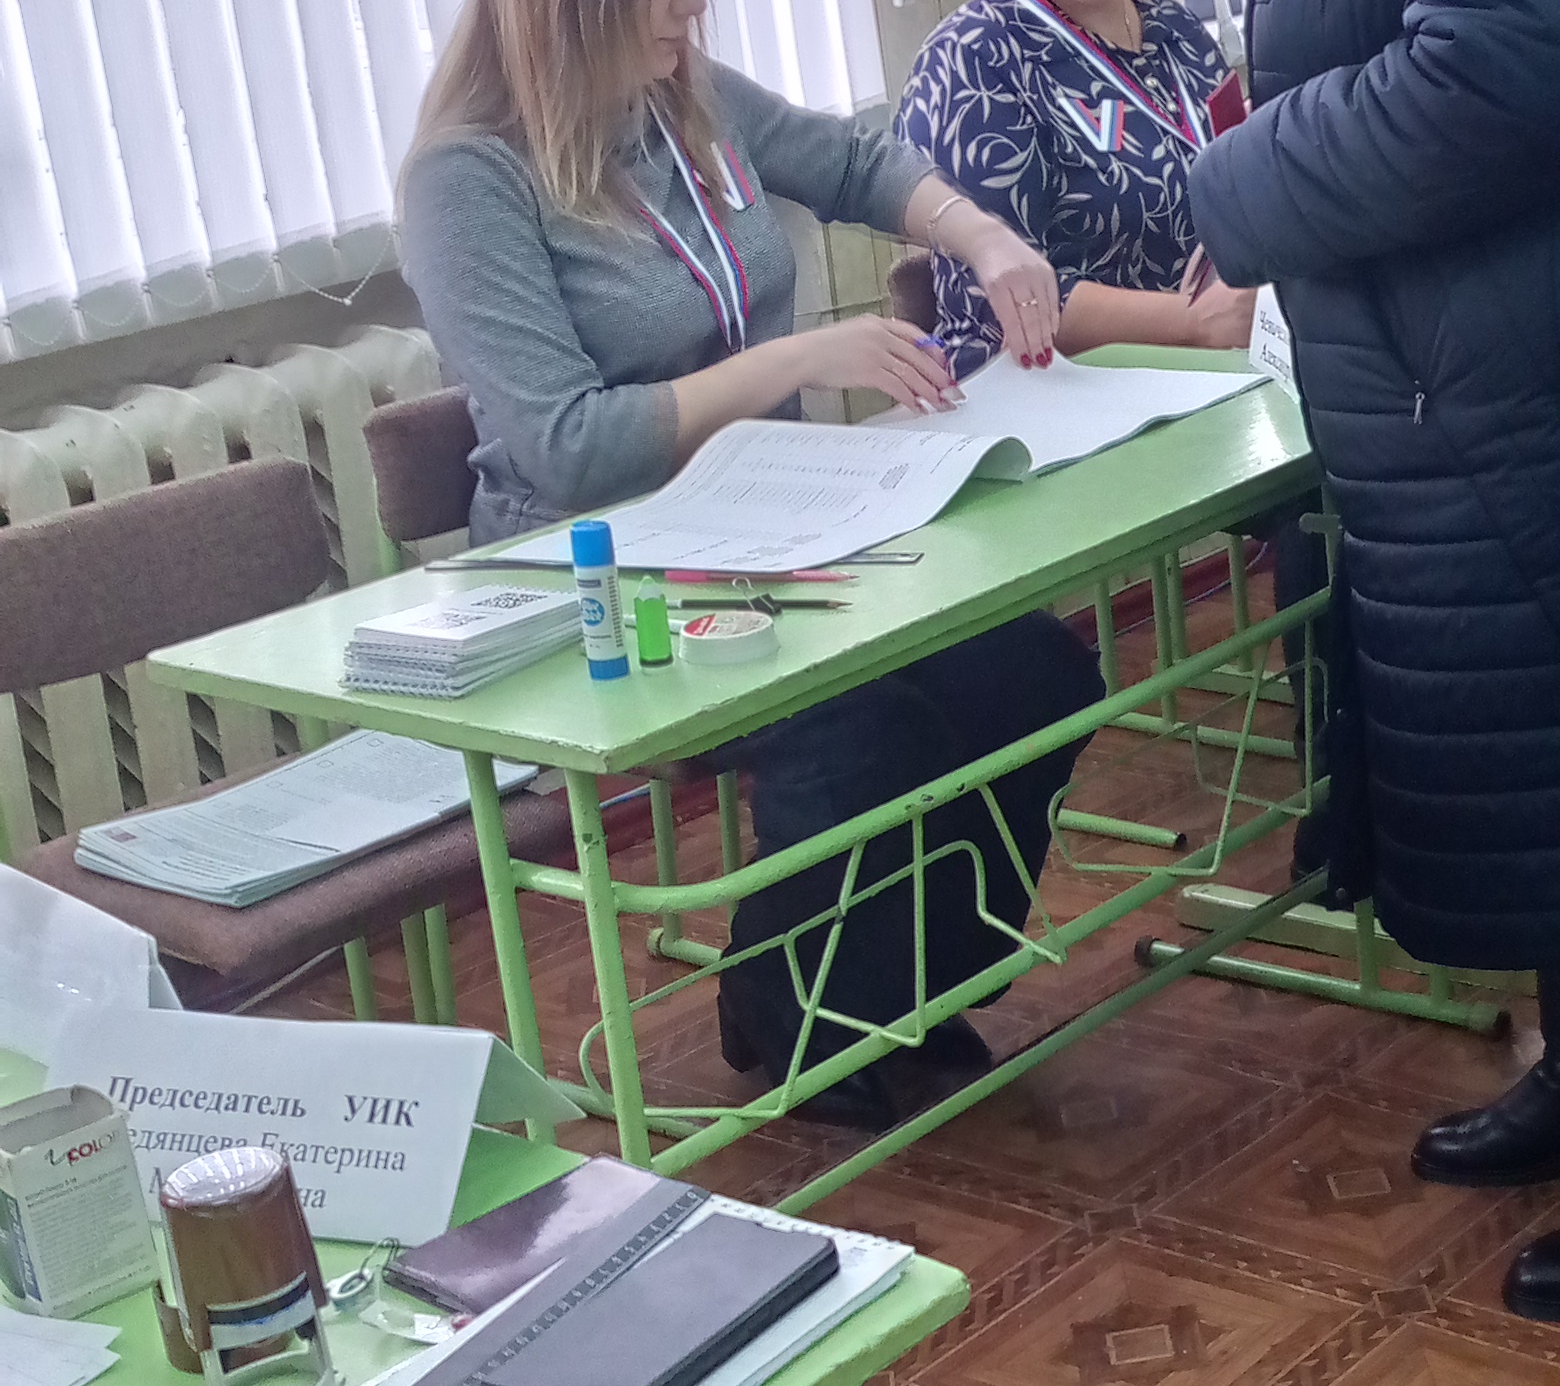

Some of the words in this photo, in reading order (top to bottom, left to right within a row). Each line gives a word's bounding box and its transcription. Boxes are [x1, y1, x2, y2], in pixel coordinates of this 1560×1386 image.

[109, 1075, 307, 1118] Председатель
[344, 1094, 420, 1128] УИК
[127, 1128, 248, 1155] едянцева
[261, 1132, 407, 1174] Екатерина
